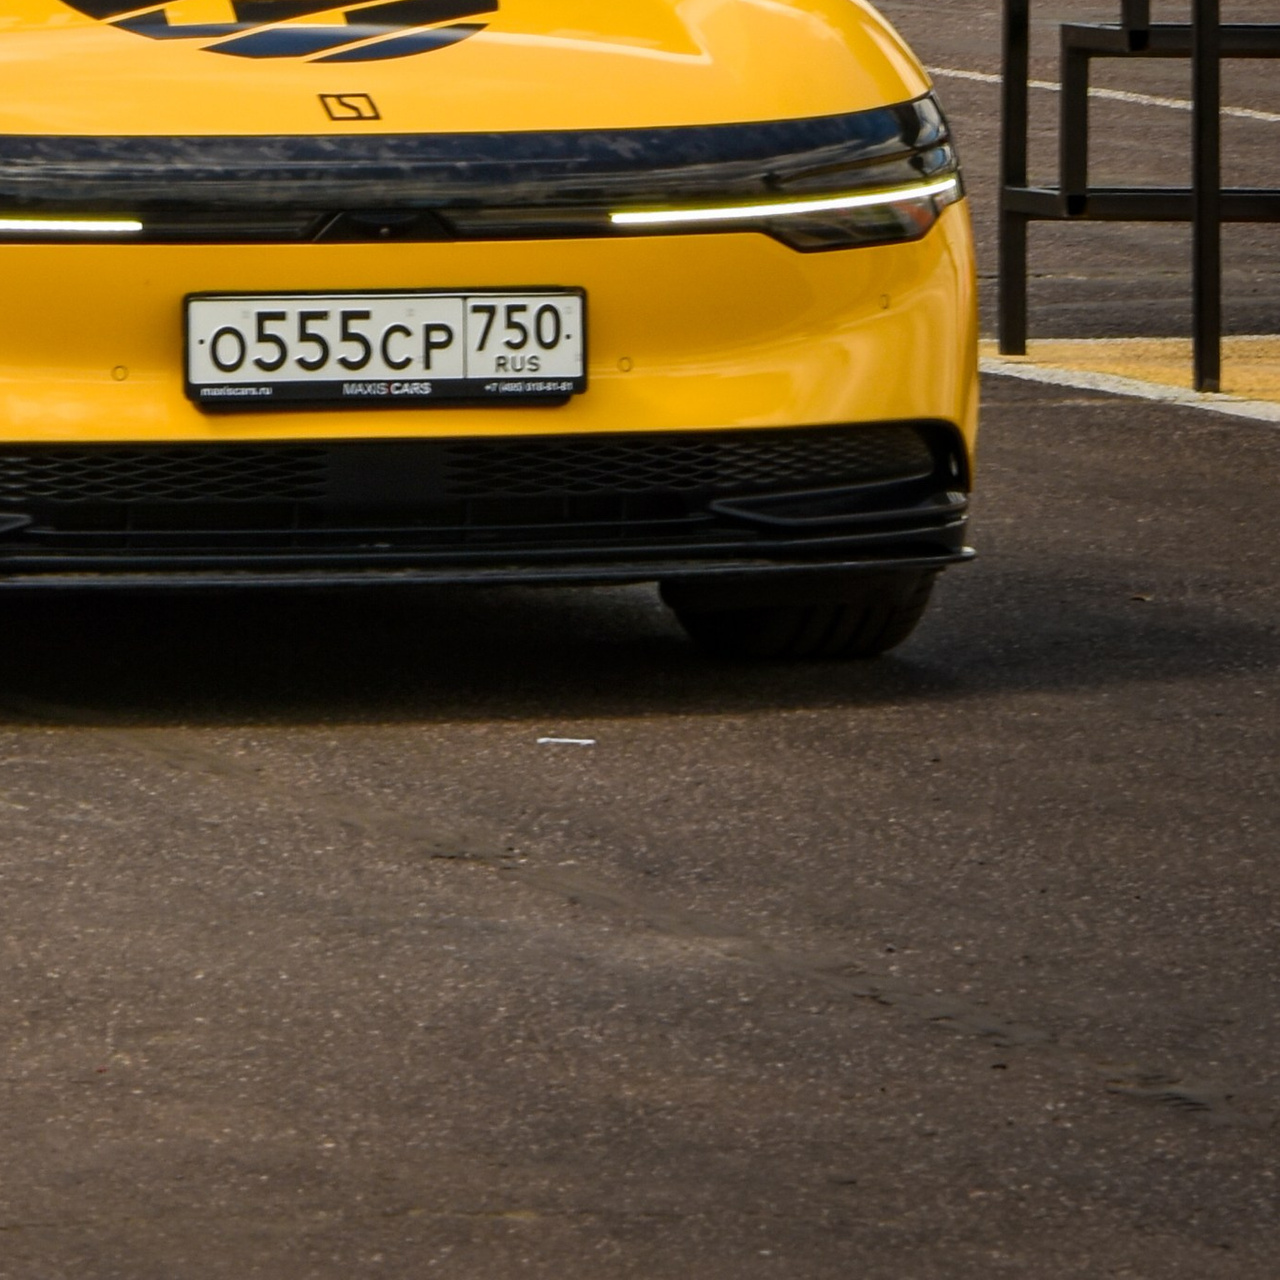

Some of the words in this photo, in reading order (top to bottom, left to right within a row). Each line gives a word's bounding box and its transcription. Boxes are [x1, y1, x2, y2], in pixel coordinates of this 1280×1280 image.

[471, 304, 562, 351] 750
[495, 355, 541, 373] RUS
[342, 382, 389, 396] MAXIS
[390, 381, 432, 395] CARS
